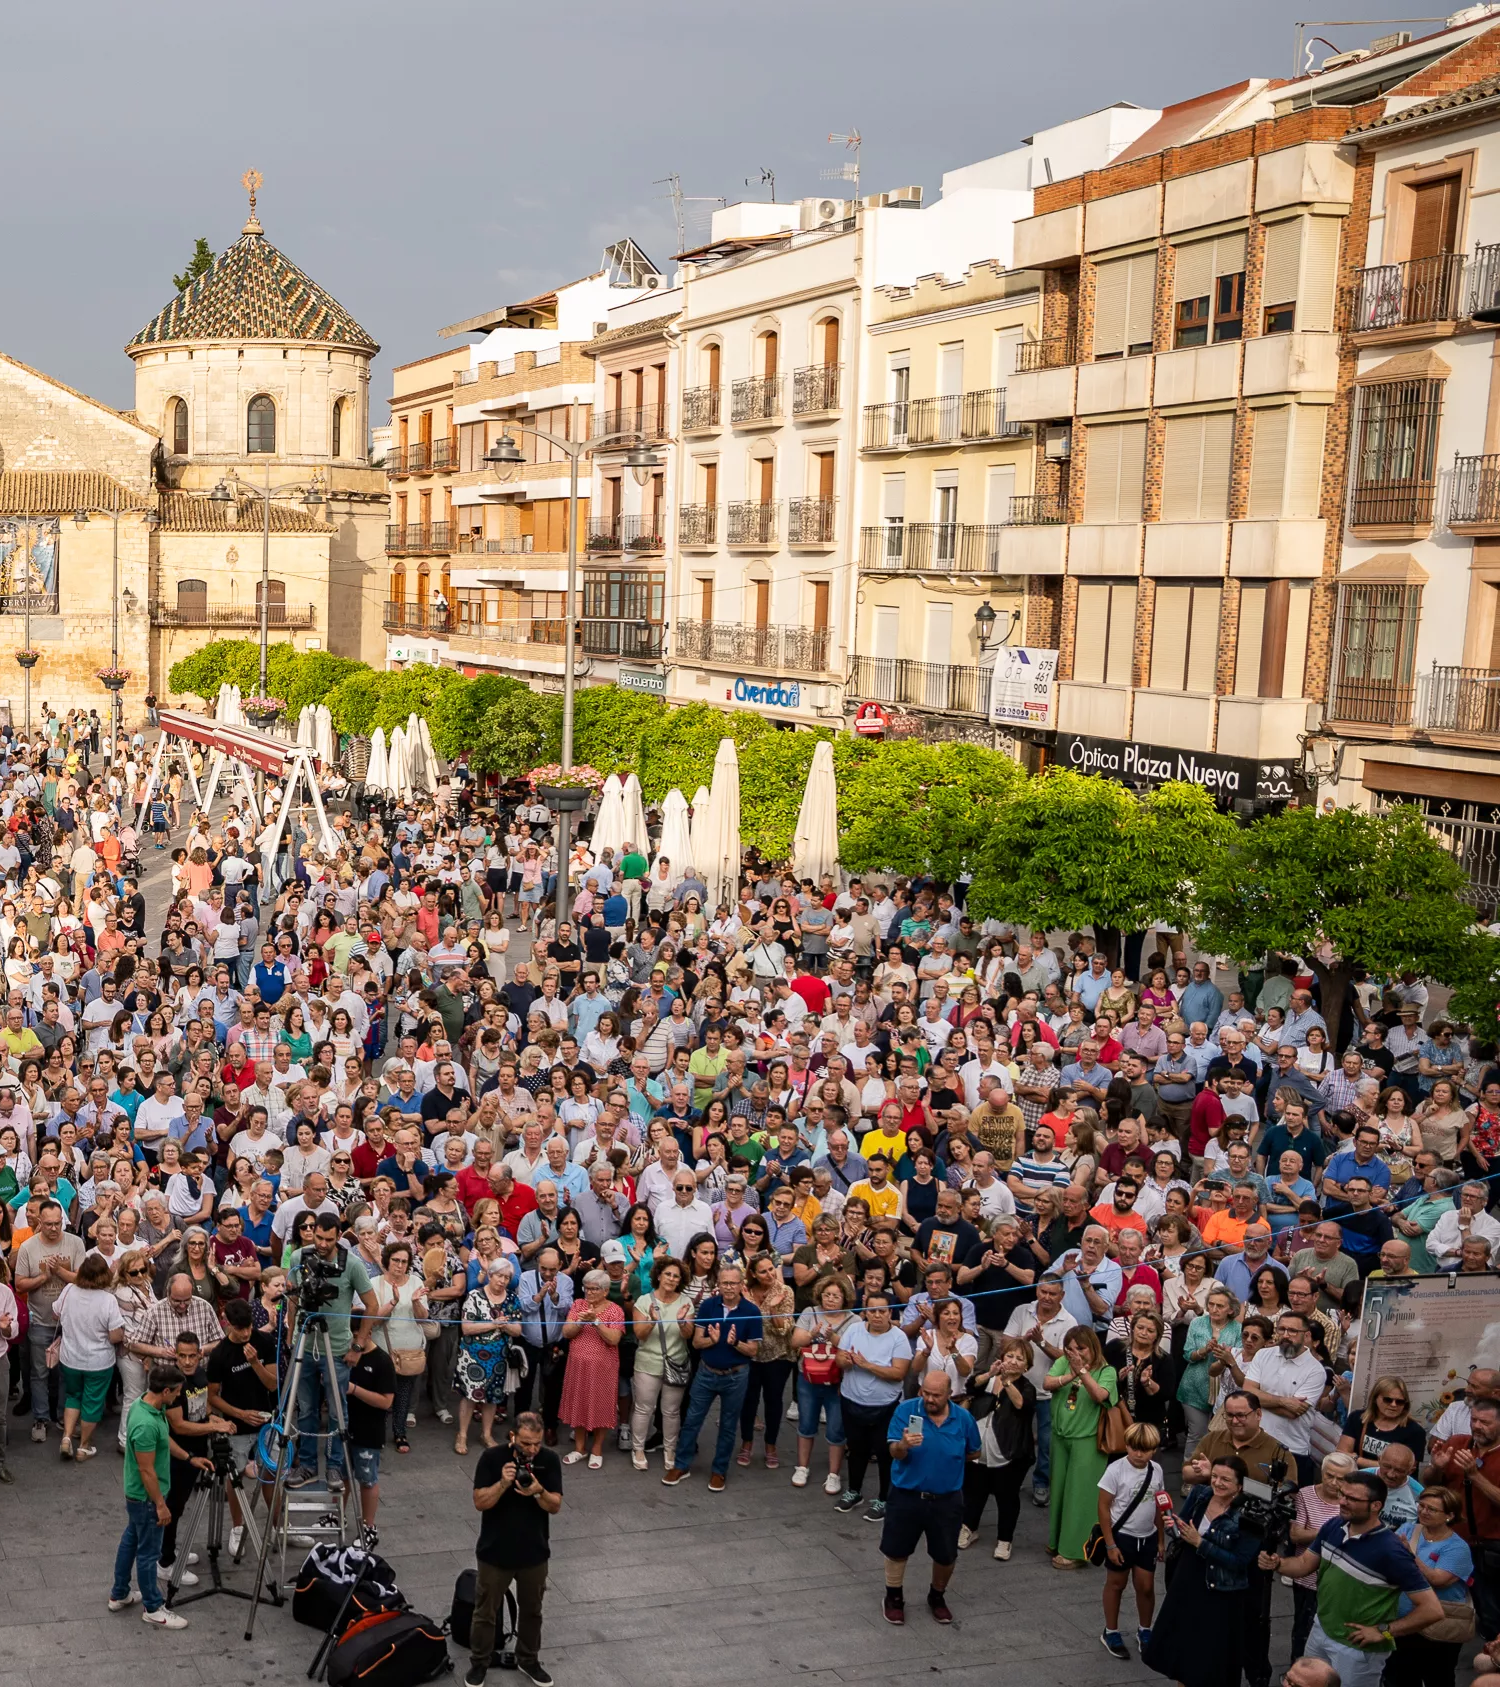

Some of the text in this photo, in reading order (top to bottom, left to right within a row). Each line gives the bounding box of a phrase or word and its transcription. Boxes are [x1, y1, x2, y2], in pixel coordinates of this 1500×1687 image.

[2, 599, 47, 607] SERVTAS
[1038, 661, 1054, 671] 675
[1035, 672, 1050, 682] 461
[1033, 683, 1048, 694] 900
[1069, 736, 1240, 791] Óptica Plaza Nueva
[535, 811, 541, 821] 7
[982, 1115, 1014, 1125] SURVIVOR
[1366, 1296, 1383, 1341] 5
[1385, 1308, 1395, 1322] de
[1393, 1308, 1416, 1326] junio
